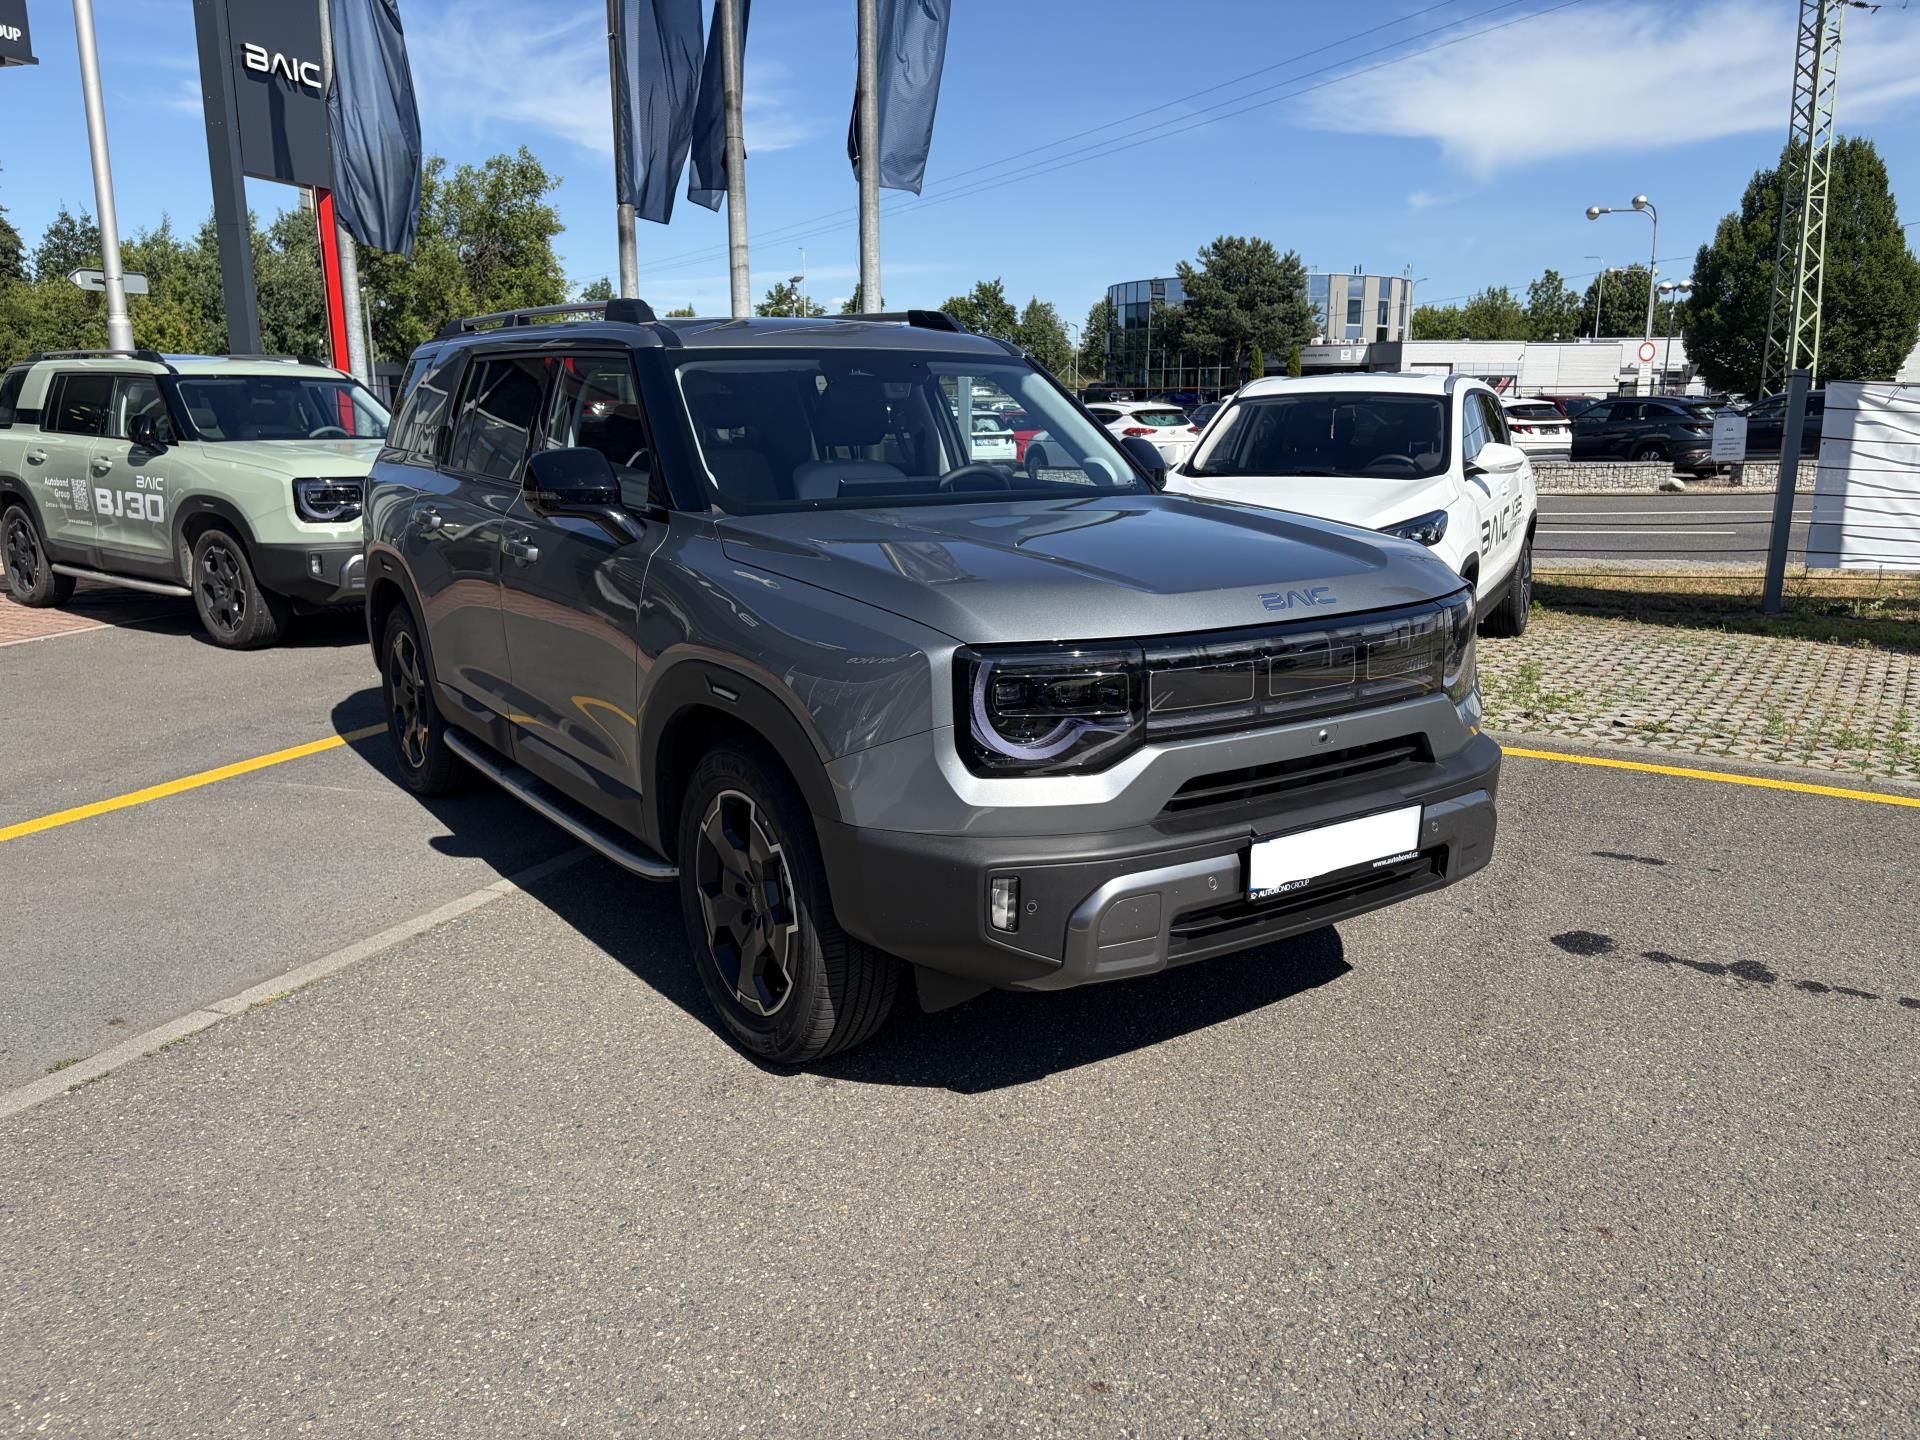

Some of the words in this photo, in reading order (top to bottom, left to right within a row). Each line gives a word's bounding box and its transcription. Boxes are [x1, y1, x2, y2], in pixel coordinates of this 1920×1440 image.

[244, 42, 322, 89] BAIC
[136, 475, 164, 490] BAIC
[54, 488, 70, 500] Group
[95, 488, 164, 523] BJ30
[1481, 505, 1510, 557] BAIC
[1257, 587, 1337, 611] BAIC
[1373, 851, 1419, 868] www.autobond.cz
[1258, 883, 1291, 898] AUTOBOND
[1290, 878, 1310, 890] GROUP
